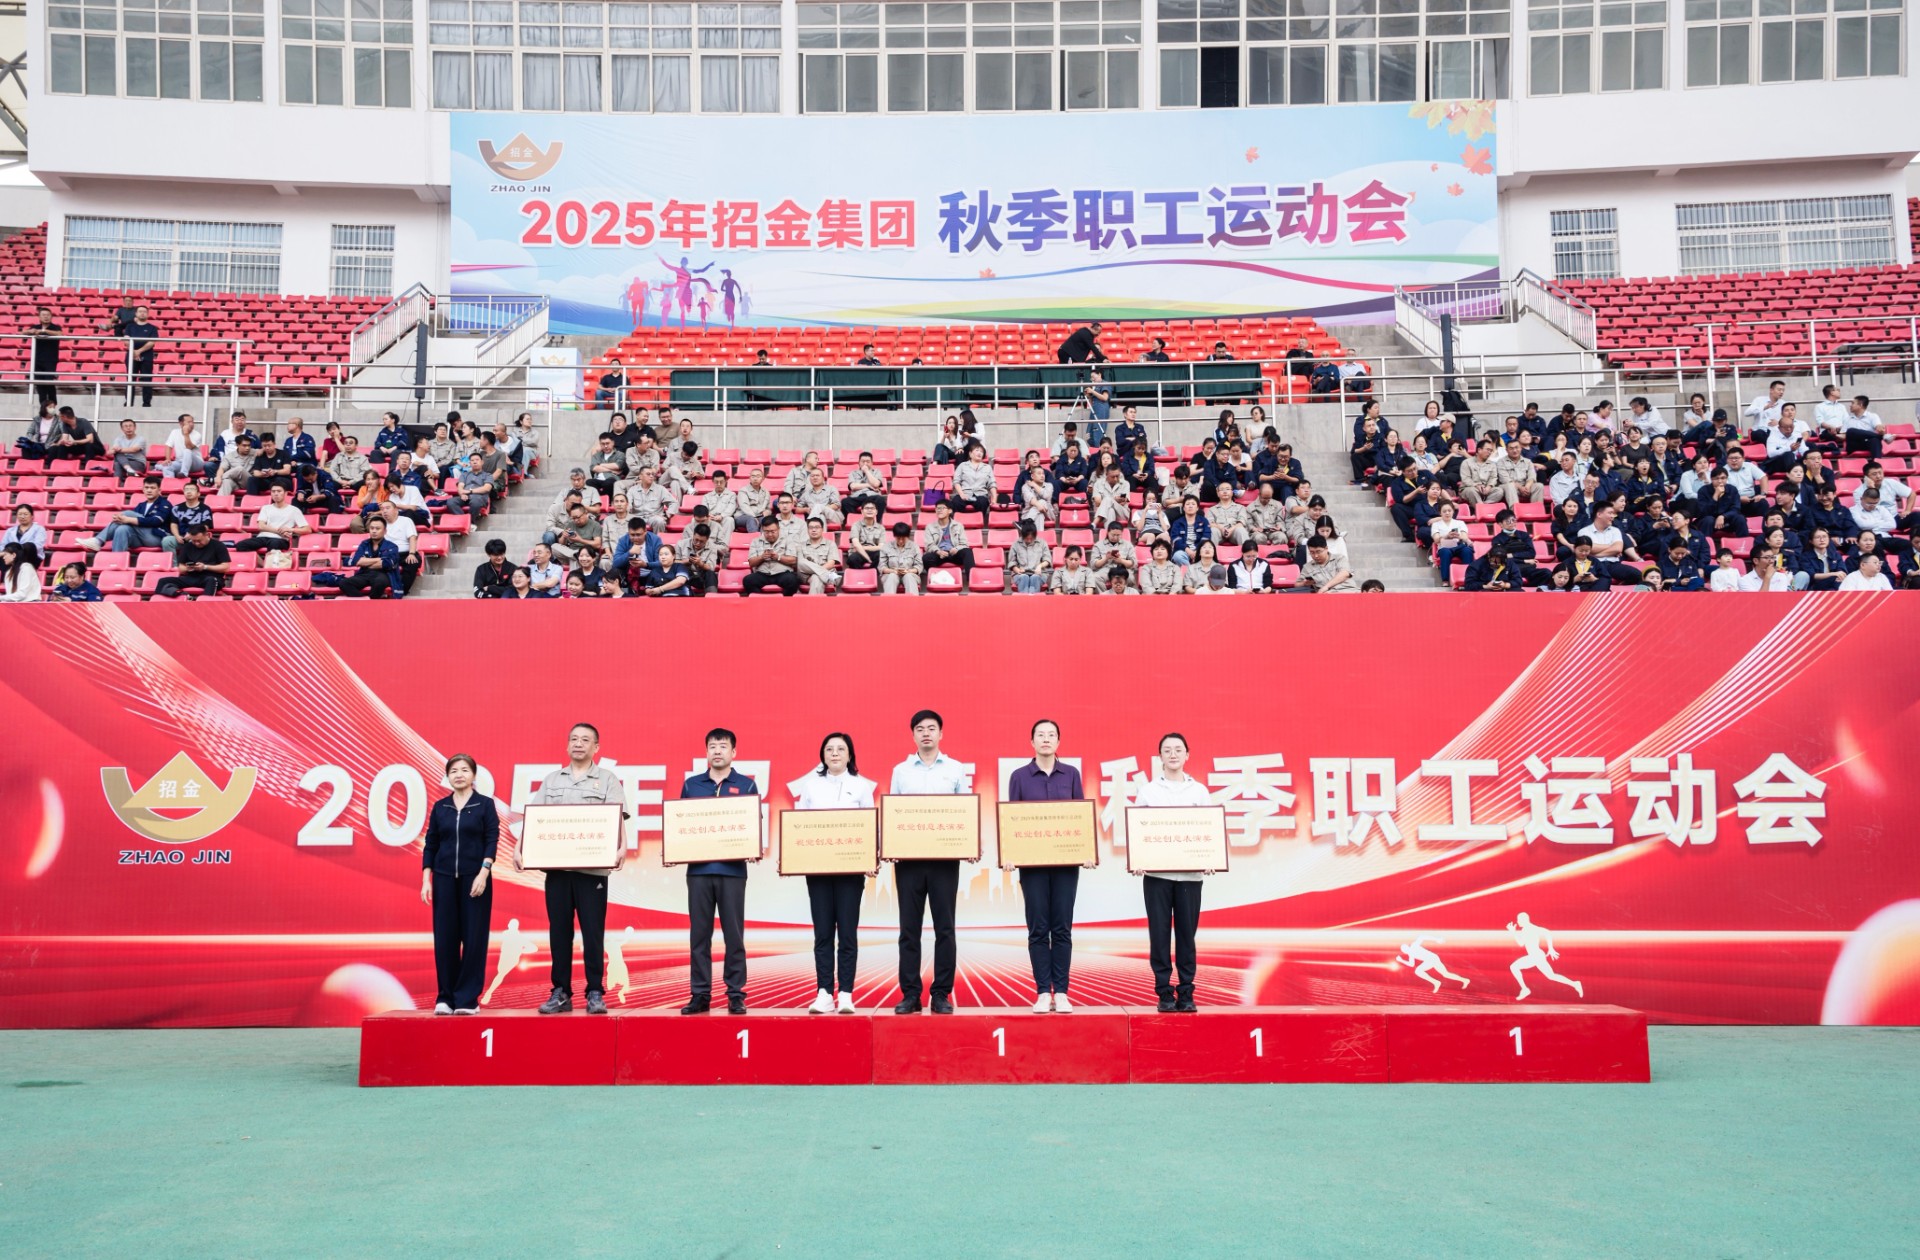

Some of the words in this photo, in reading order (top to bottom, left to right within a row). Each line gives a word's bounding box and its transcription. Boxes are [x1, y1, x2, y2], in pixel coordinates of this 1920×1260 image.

[510, 147, 534, 158] 招金
[490, 185, 526, 193] ZHAO
[530, 185, 551, 193] JIN
[520, 199, 916, 249] 2025年招金集团
[938, 179, 1409, 254] 秋季职工运动会
[158, 779, 202, 799] 招金
[118, 849, 185, 865] ZHAO
[191, 849, 232, 864] JIN
[481, 1028, 495, 1058] 1
[736, 1028, 749, 1058] 1
[993, 1027, 1006, 1057] 1
[1249, 1027, 1262, 1057] 1
[1509, 1026, 1522, 1056] 1
